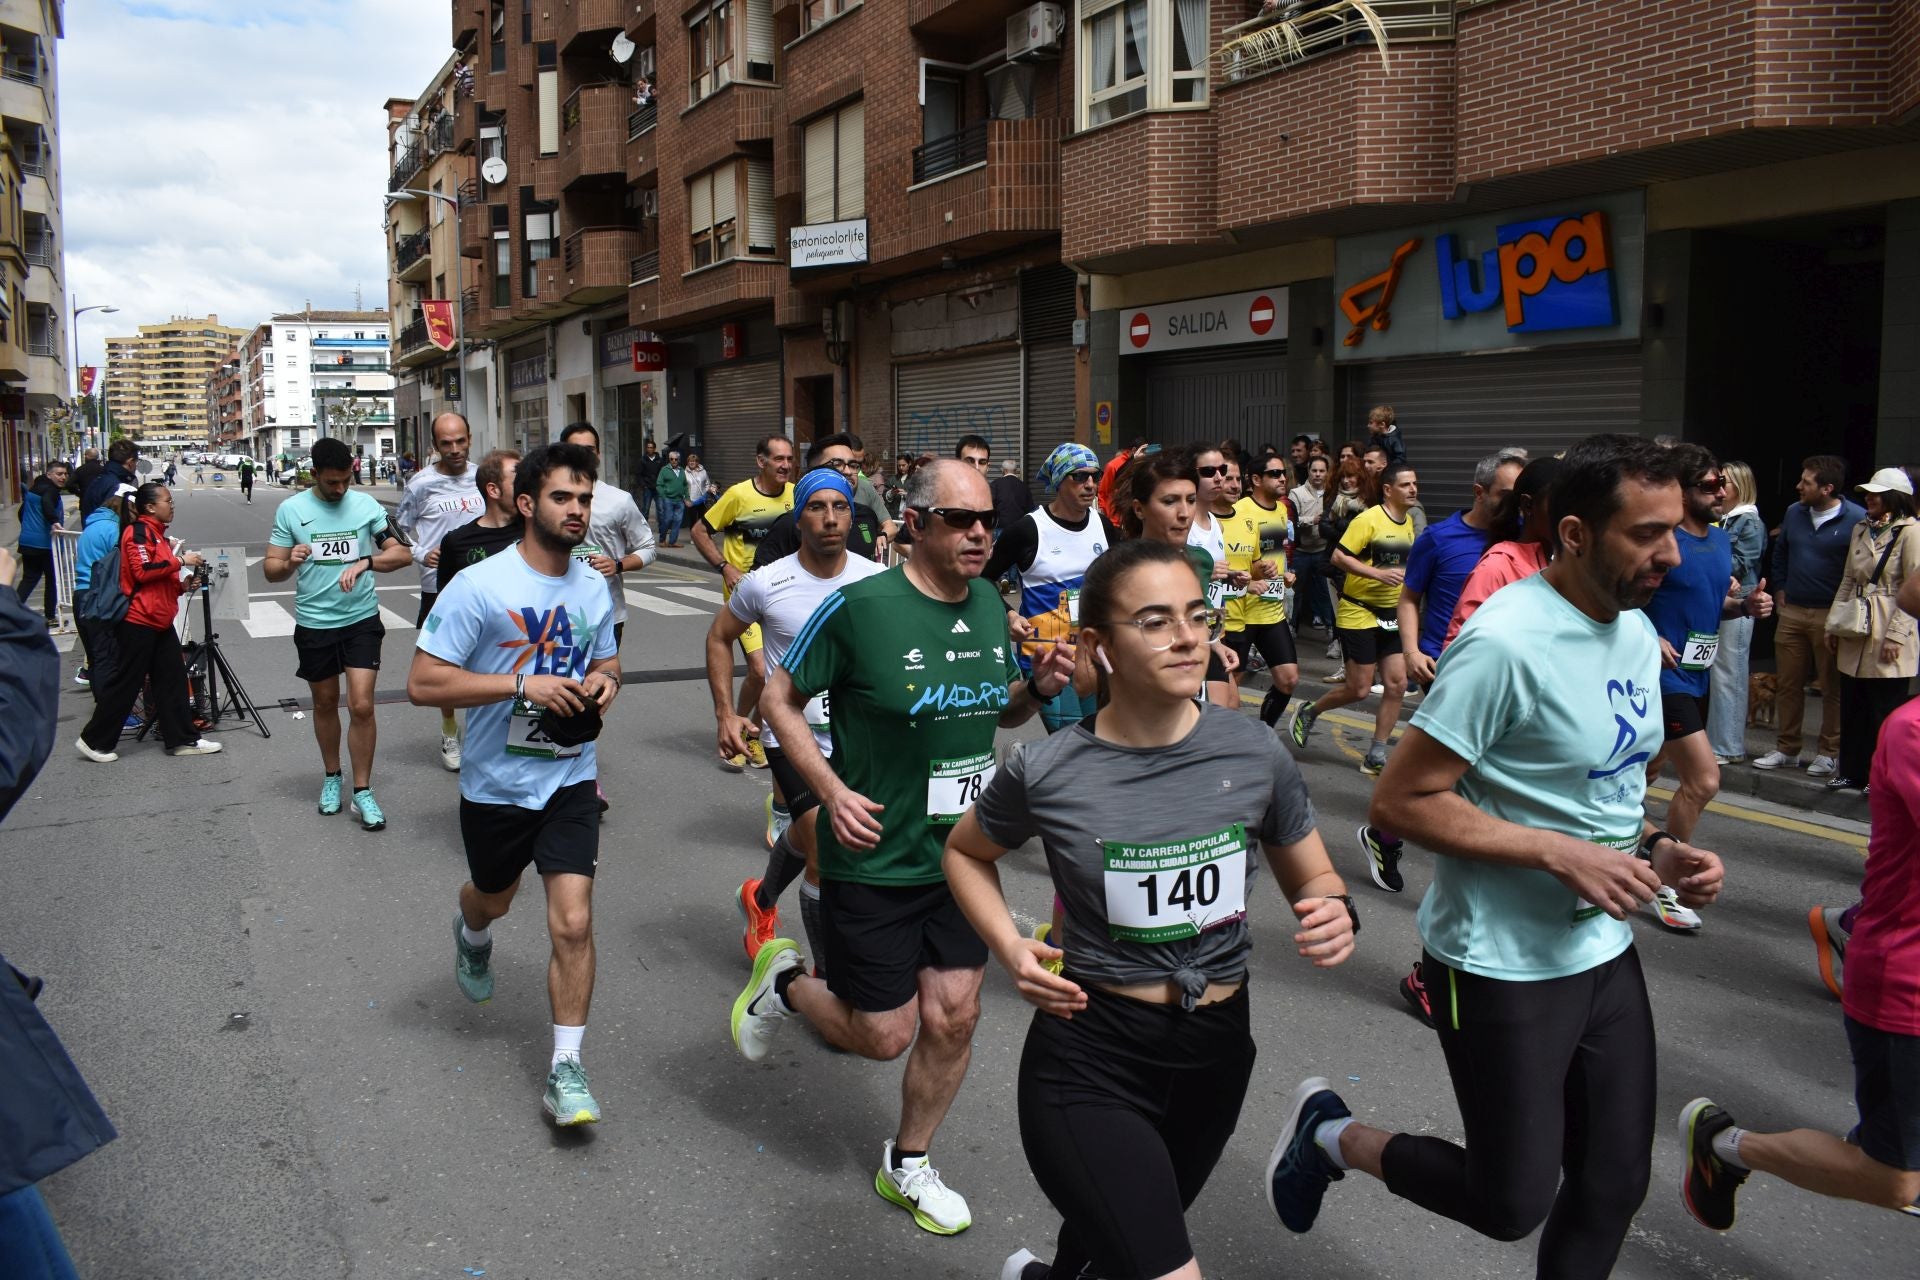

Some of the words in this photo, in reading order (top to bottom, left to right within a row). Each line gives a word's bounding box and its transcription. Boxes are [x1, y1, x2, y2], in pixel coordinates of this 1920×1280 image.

[792, 228, 864, 248] @monicolorlife
[1436, 211, 1609, 328] lupa
[1168, 310, 1228, 336] SALIDA
[322, 541, 349, 556] 240
[1269, 582, 1283, 594] 246
[521, 605, 573, 647] VA
[958, 650, 980, 659] ZURICH
[1693, 645, 1716, 660] 267
[910, 682, 1009, 715] MADRID
[958, 773, 982, 805] 78
[1110, 859, 1158, 869] CALAHORRA
[1160, 855, 1188, 868] CIUDAD
[1190, 852, 1199, 863] DE
[1200, 849, 1209, 860] LA
[1211, 840, 1241, 857] VERDURA
[1122, 848, 1136, 857] XV
[1139, 844, 1186, 857] CARRERA
[1189, 832, 1230, 850] POPULAR
[1138, 864, 1220, 916] 140
